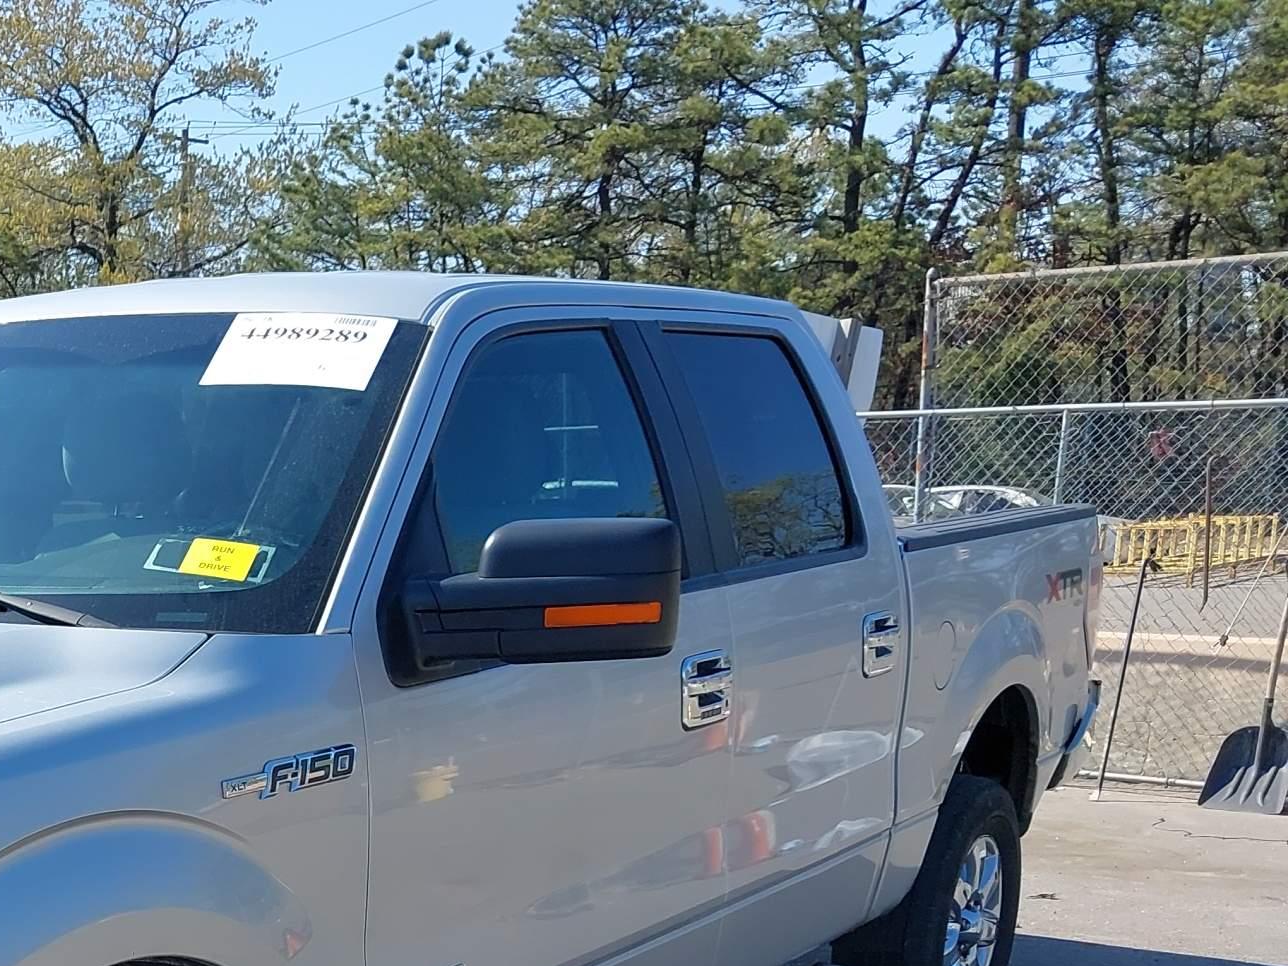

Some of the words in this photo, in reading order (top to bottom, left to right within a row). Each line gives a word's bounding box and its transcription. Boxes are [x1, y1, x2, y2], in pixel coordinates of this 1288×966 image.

[240, 327, 368, 343] 44989289
[212, 545, 235, 554] RUN
[198, 562, 231, 572] DRIVE
[1045, 568, 1083, 604] XTR
[267, 745, 356, 795] F-150
